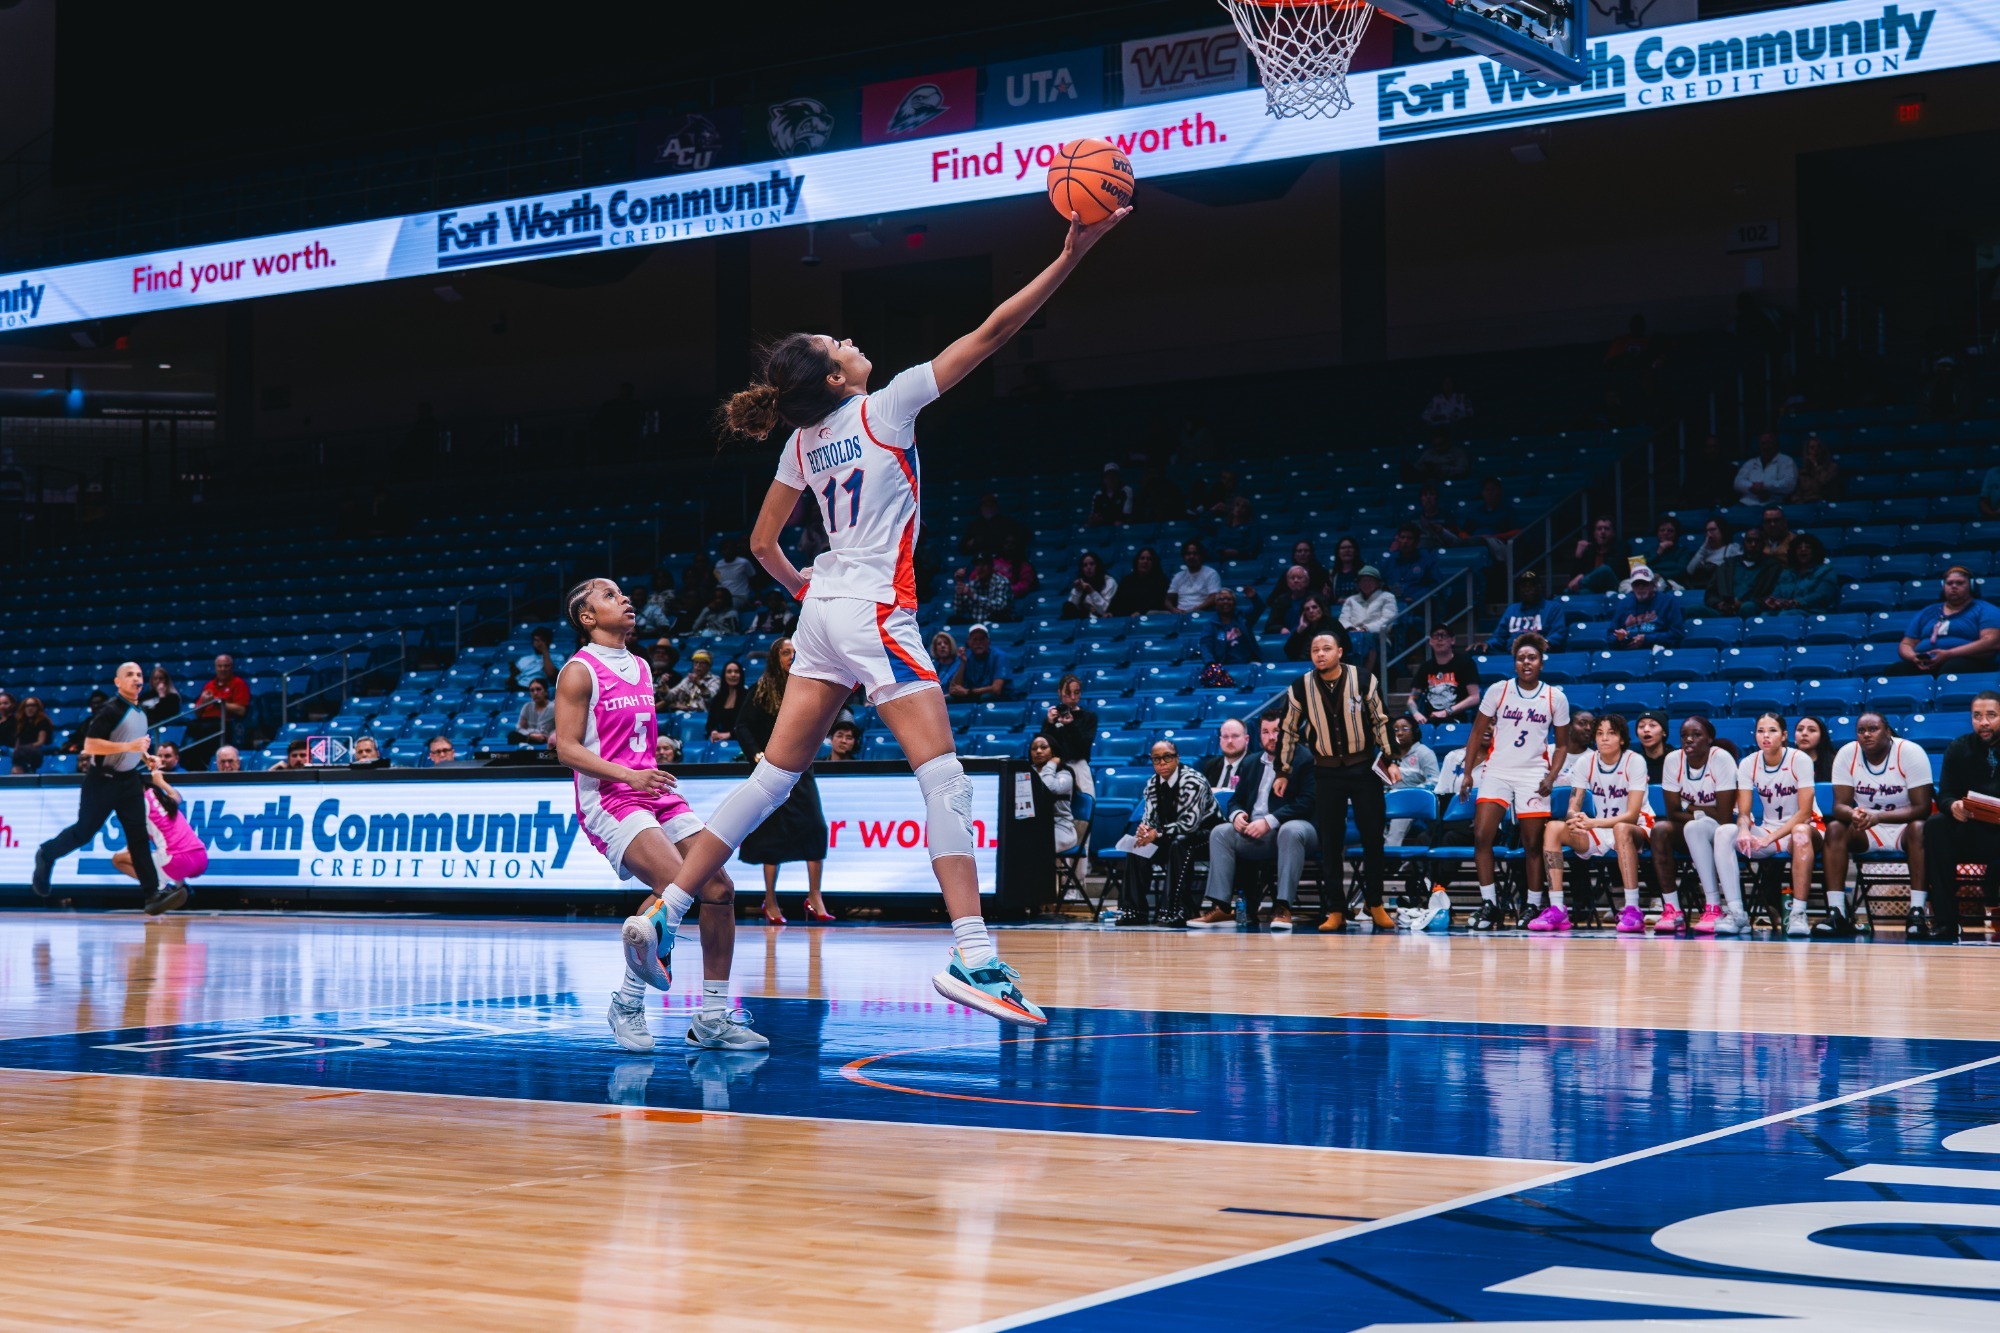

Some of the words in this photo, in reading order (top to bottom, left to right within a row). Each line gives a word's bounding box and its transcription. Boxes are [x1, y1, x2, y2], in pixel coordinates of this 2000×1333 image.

[1131, 32, 1241, 88] WAC
[1378, 68, 1469, 121] Fort
[1479, 41, 1626, 105] Wth
[1634, 4, 1936, 84] Community
[1006, 67, 1078, 107] UTA
[1638, 73, 1764, 106] CREDIT
[1783, 53, 1900, 87] UNION
[662, 137, 713, 170] ACU
[931, 141, 1004, 183] Find
[1015, 142, 1064, 180] yo
[1105, 112, 1228, 158] worth.
[1111, 157, 1134, 180] CAA
[437, 211, 499, 252] Fort
[506, 193, 602, 242] Worth
[608, 170, 805, 229] Community
[609, 221, 694, 247] CREDIT
[705, 209, 783, 234] UNION
[1738, 224, 1769, 242] 102
[132, 261, 183, 293] Find
[190, 259, 246, 293] your
[252, 240, 337, 277] worth.
[806, 435, 863, 474] REYNOLDS
[821, 467, 865, 534] 11
[1508, 613, 1543, 633] UTA
[603, 694, 640, 712] UTAH
[1502, 705, 1523, 727] Lady
[629, 712, 652, 753] 5
[1513, 730, 1529, 748] 3
[1855, 780, 1878, 803] Lady
[1774, 805, 1783, 821] 1
[181, 796, 304, 851] Worth
[311, 798, 580, 869] Community
[310, 858, 423, 878] CREDIT
[441, 858, 546, 879] UNION
